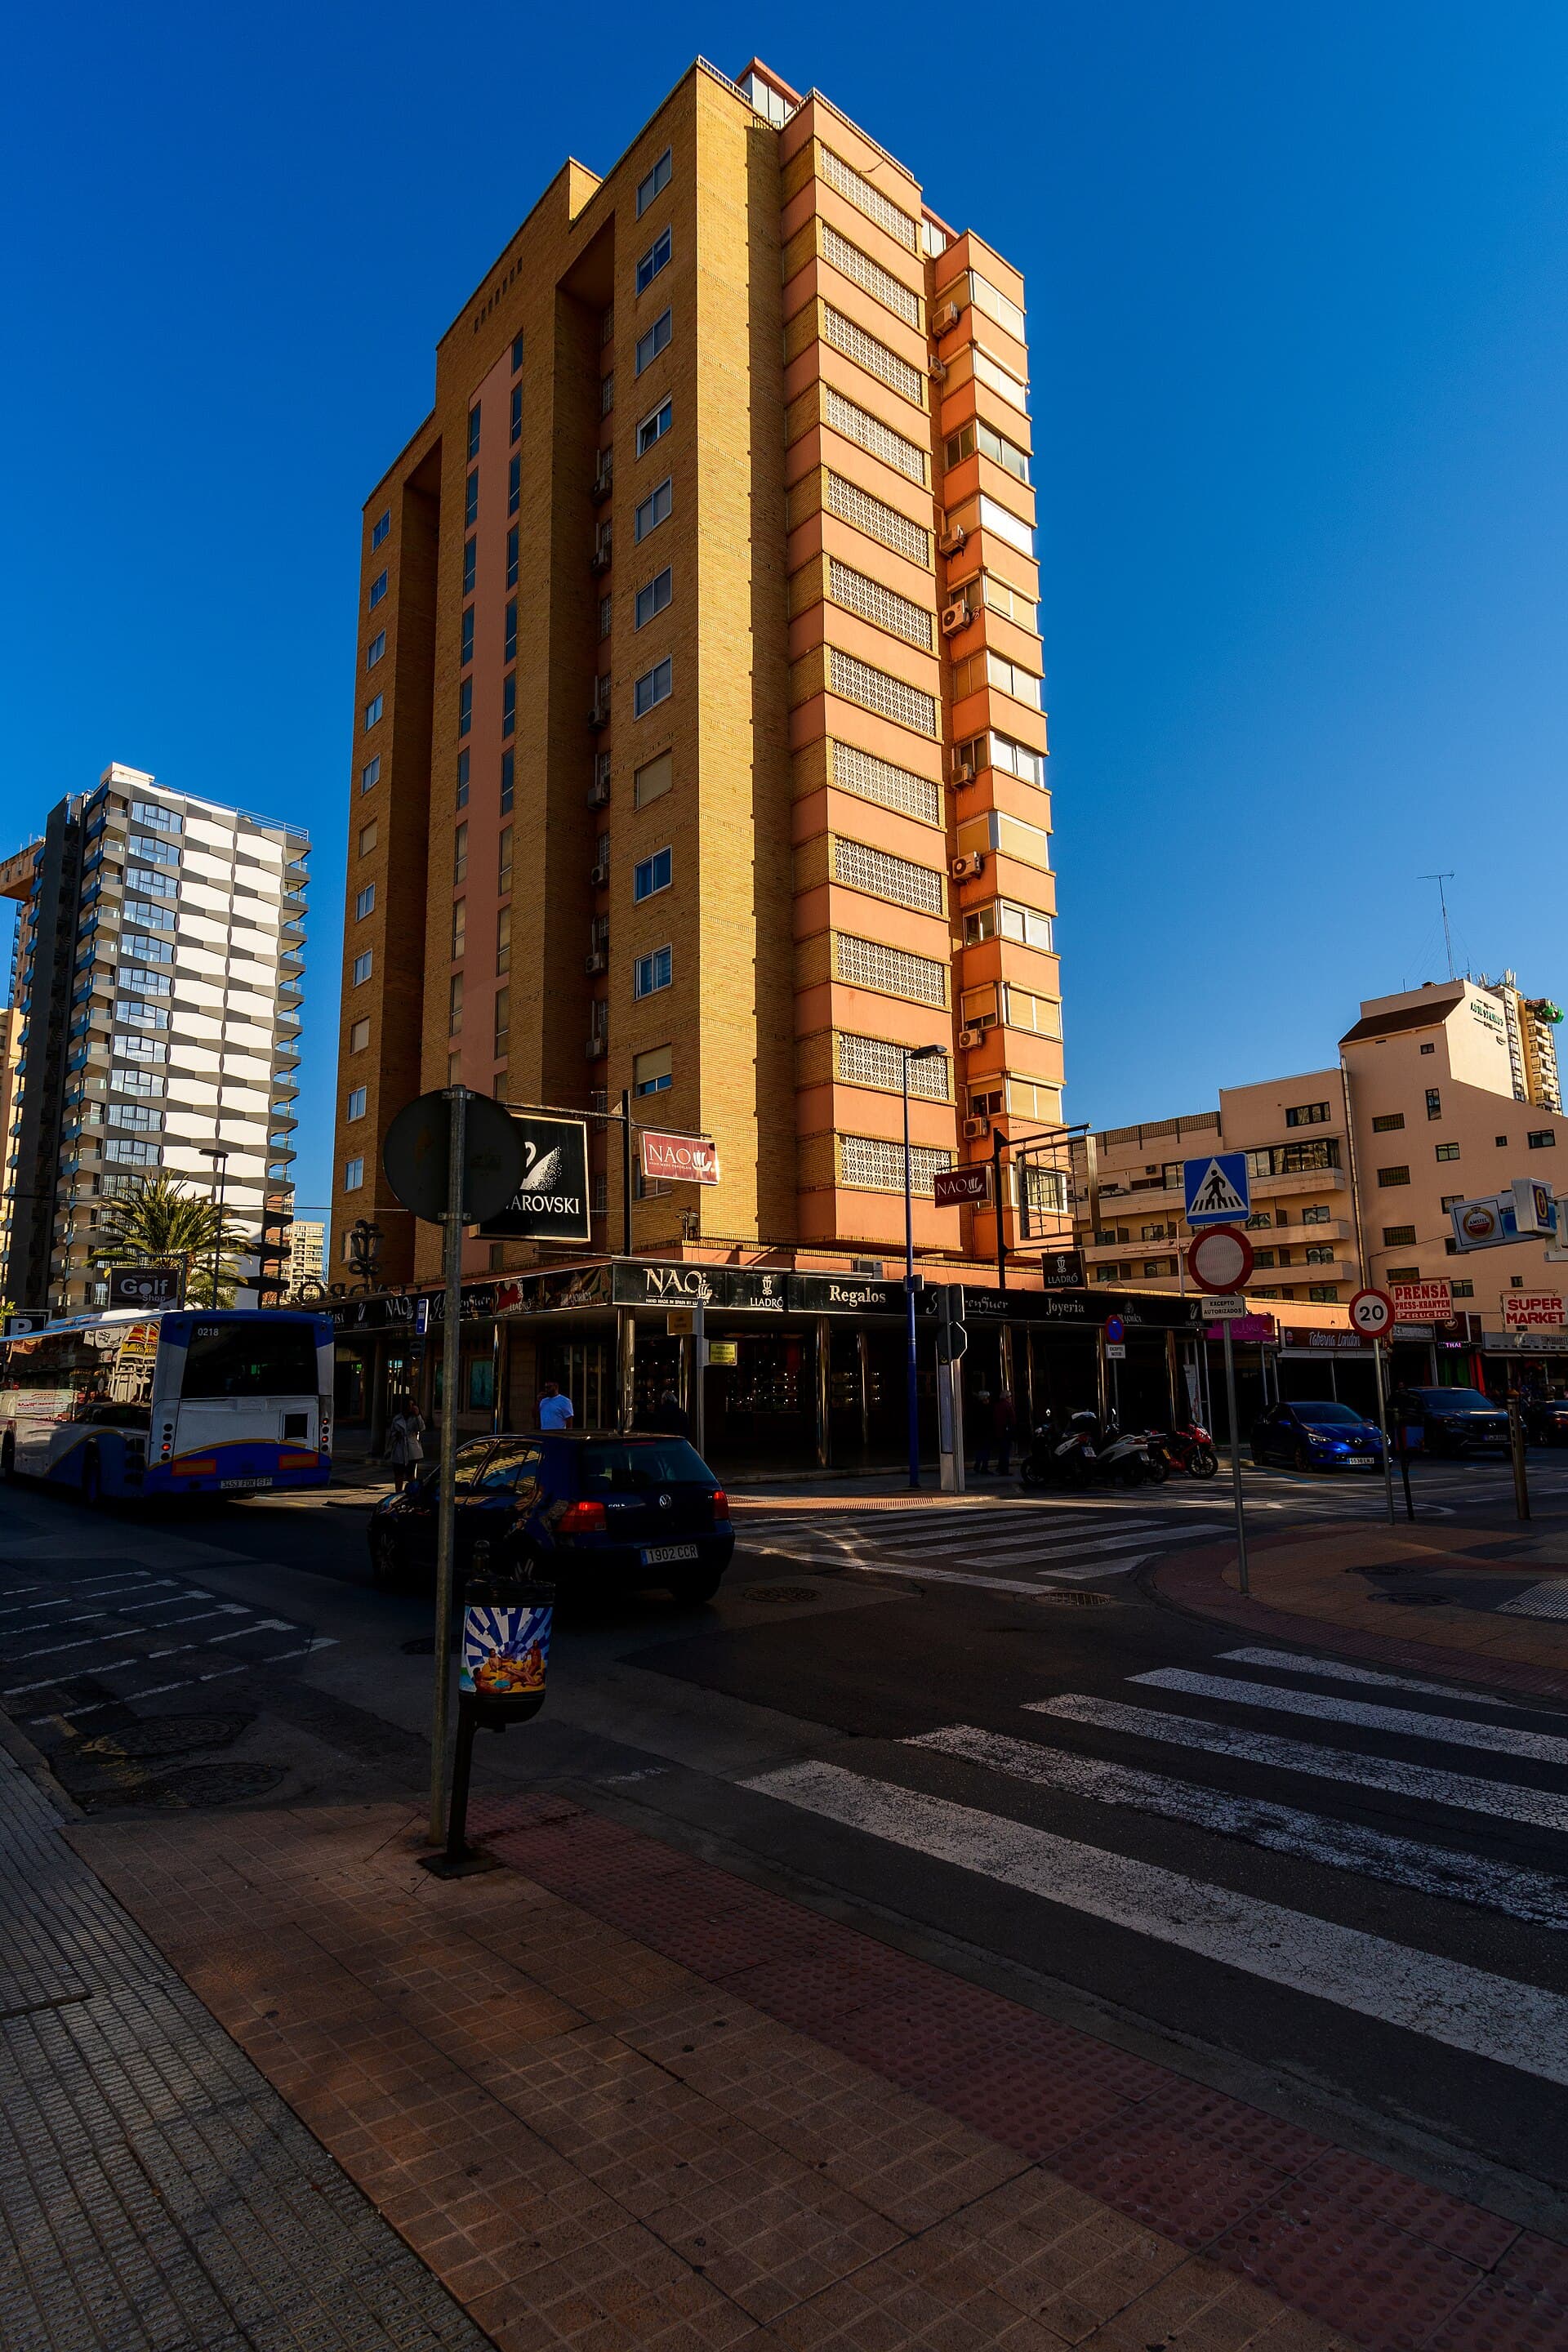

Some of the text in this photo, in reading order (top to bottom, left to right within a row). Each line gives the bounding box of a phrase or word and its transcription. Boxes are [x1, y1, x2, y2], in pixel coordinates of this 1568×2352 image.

[648, 1144, 692, 1165] NAO
[937, 1178, 967, 1196] NAO
[506, 1195, 580, 1214] AROVSKI
[120, 1278, 170, 1295] Golf
[643, 1268, 702, 1297] NAO
[1048, 1273, 1079, 1285] LLADRÓ
[829, 1285, 886, 1307] Regalos
[1395, 1285, 1449, 1300] PRENSA
[750, 1296, 783, 1311] LLADRÓ
[1508, 1298, 1563, 1310] SUPER
[1359, 1305, 1384, 1321] 20
[1506, 1312, 1566, 1324] MARKET
[10, 1319, 33, 1336] P
[198, 1327, 219, 1336] 0218
[1308, 1331, 1361, 1347] Taberna London
[649, 1545, 697, 1561] 1902 CCR
